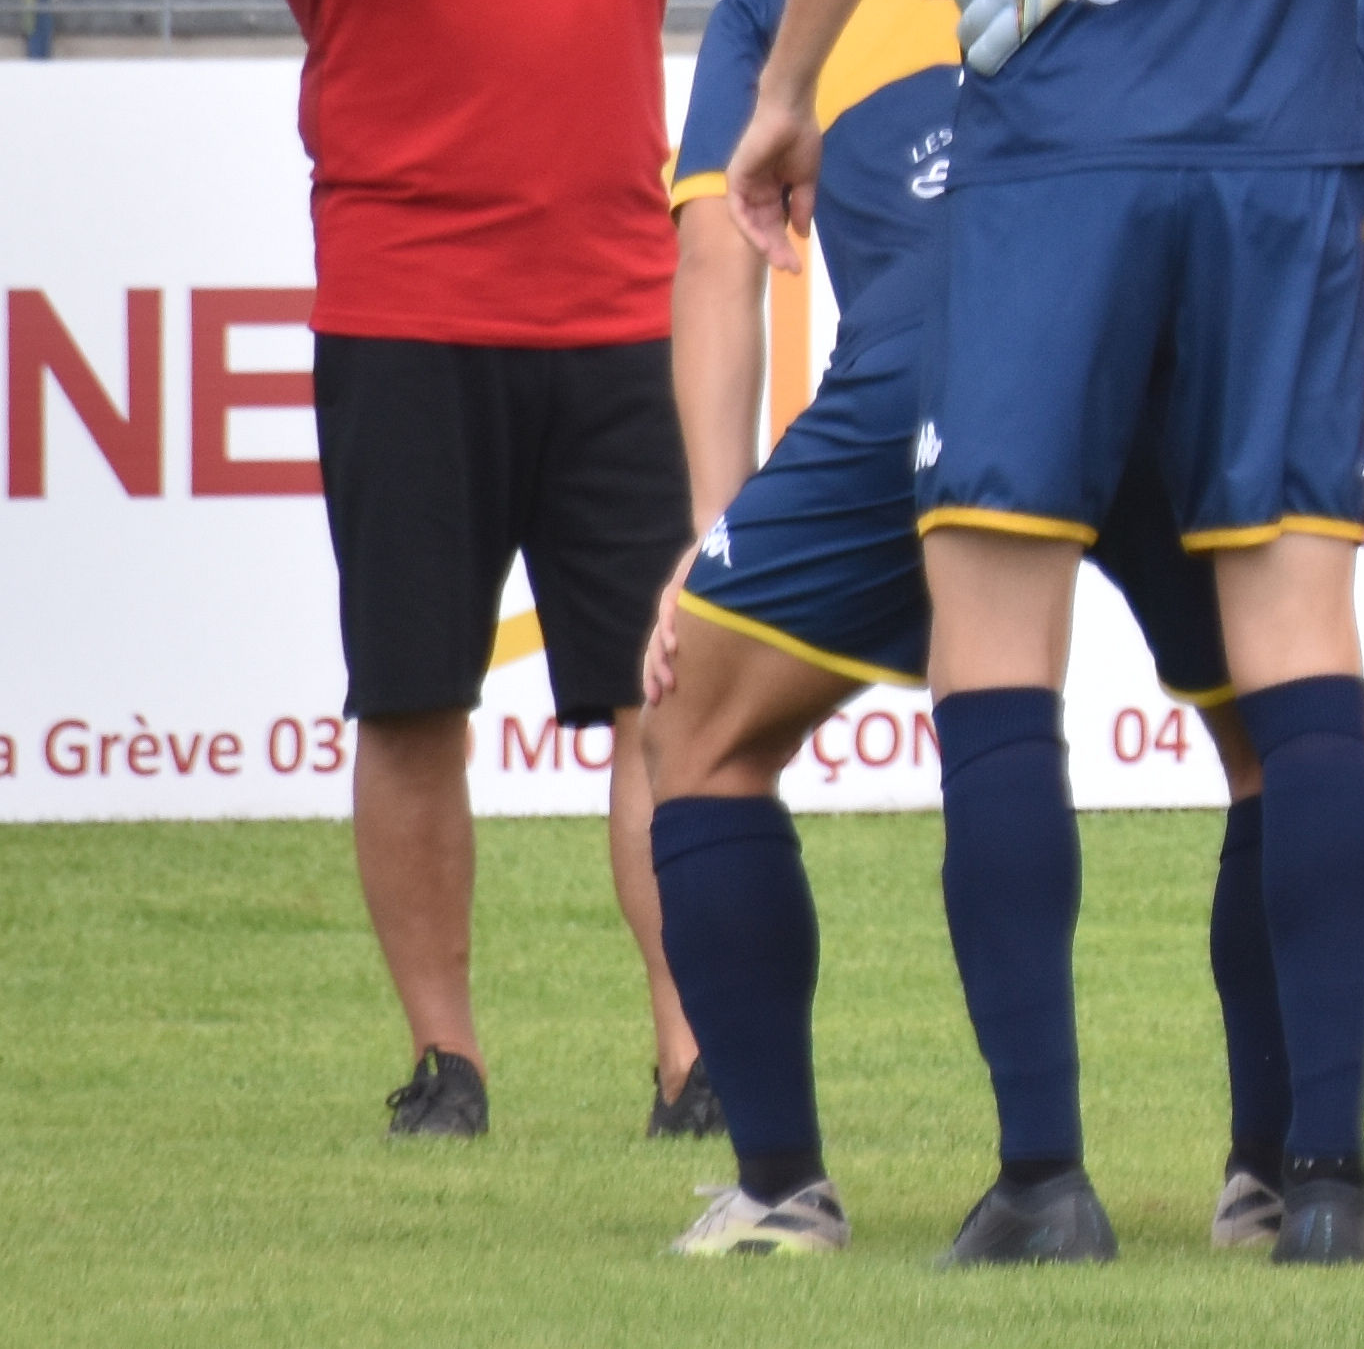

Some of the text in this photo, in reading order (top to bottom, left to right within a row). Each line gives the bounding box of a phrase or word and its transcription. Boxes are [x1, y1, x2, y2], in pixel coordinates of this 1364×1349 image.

[6, 287, 325, 499] NE
[44, 714, 243, 776] Grève
[1112, 705, 1191, 765] 04
